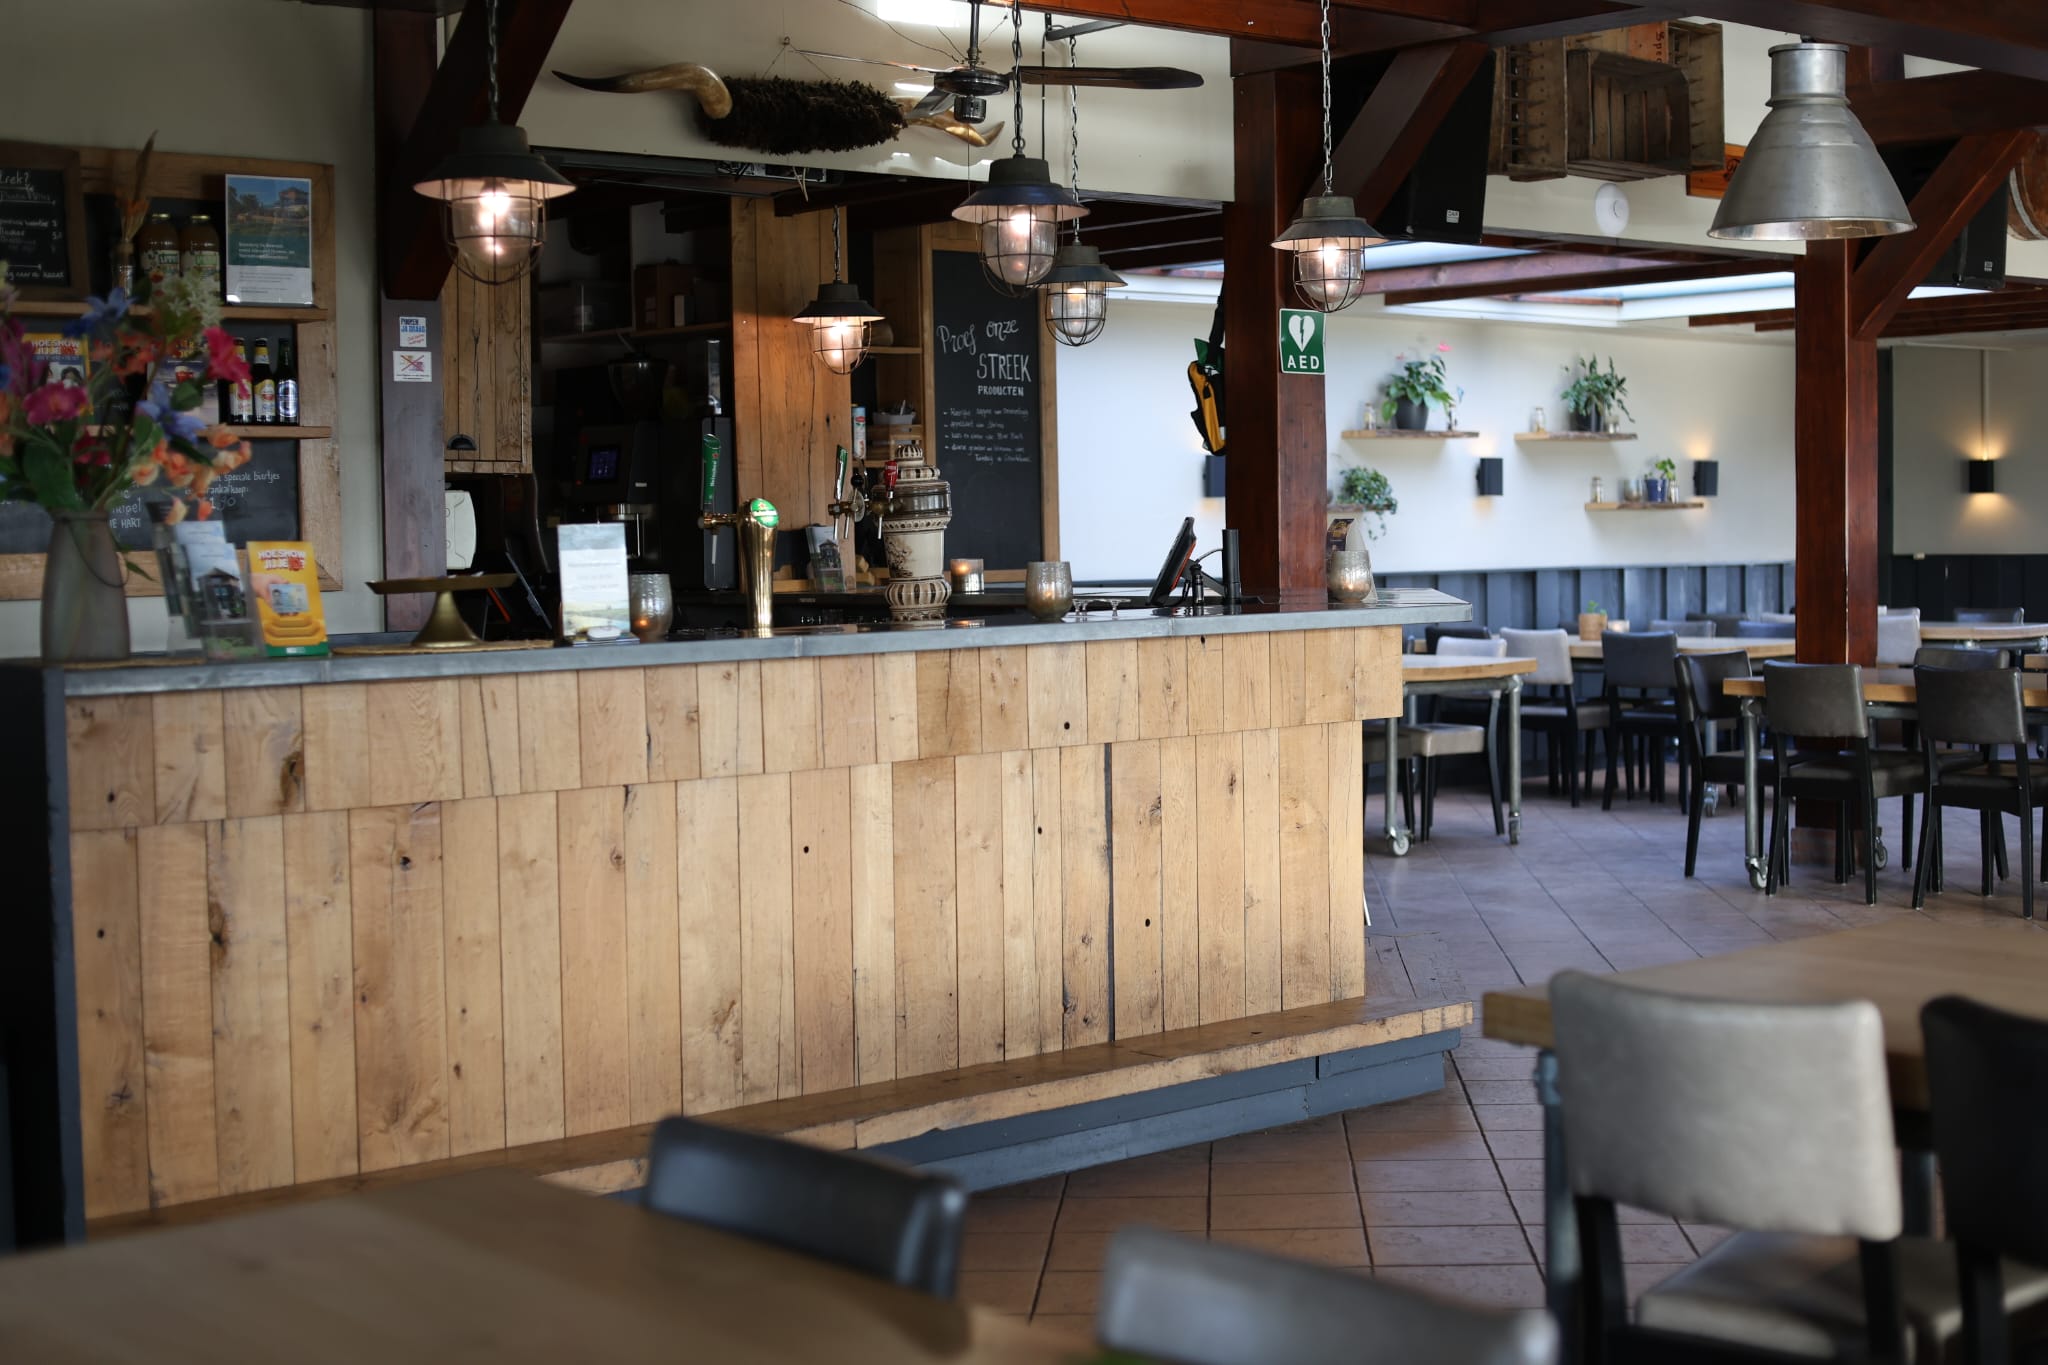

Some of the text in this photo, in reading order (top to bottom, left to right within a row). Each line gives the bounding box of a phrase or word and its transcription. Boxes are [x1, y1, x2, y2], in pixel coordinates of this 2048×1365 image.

[936, 319, 1019, 356] Proef onze
[976, 353, 1032, 382] STREEK
[1287, 355, 1320, 369] AED
[977, 385, 1025, 397] PRODUCTEN
[121, 517, 141, 529] HART
